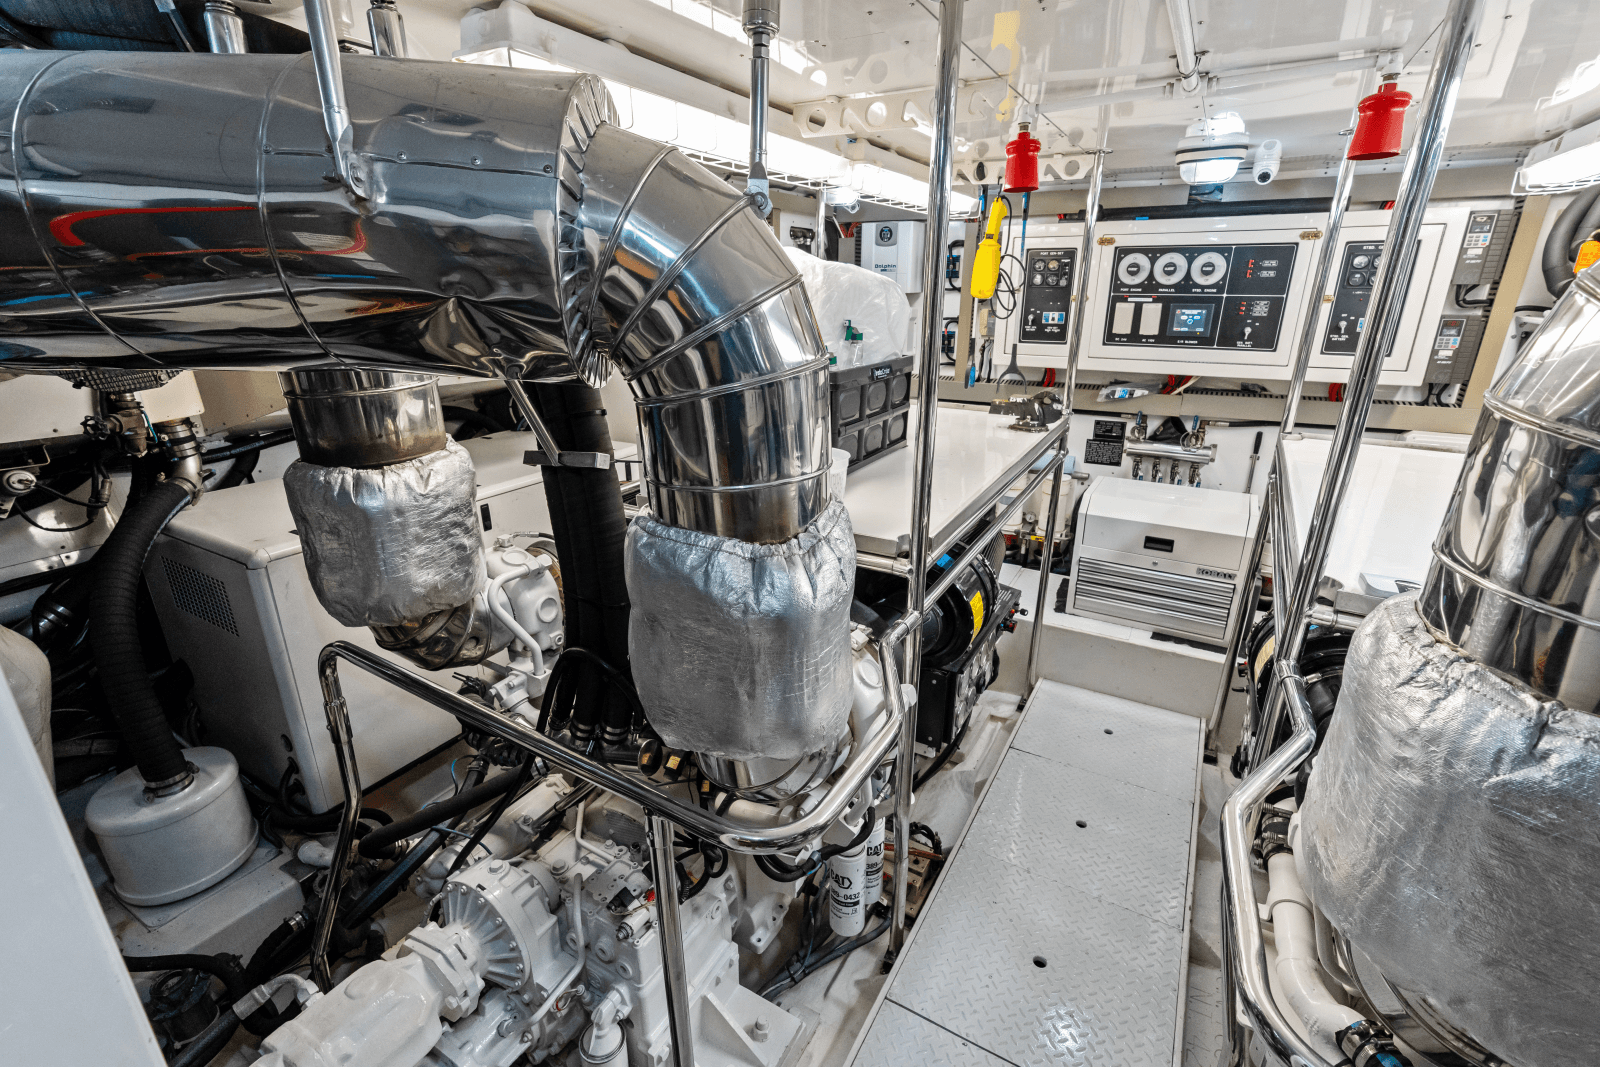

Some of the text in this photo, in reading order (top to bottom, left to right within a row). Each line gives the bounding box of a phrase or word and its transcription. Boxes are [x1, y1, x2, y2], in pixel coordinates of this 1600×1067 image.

[1196, 566, 1237, 581] KOBALT
[867, 841, 884, 857] CAT
[831, 868, 850, 888] CAT
